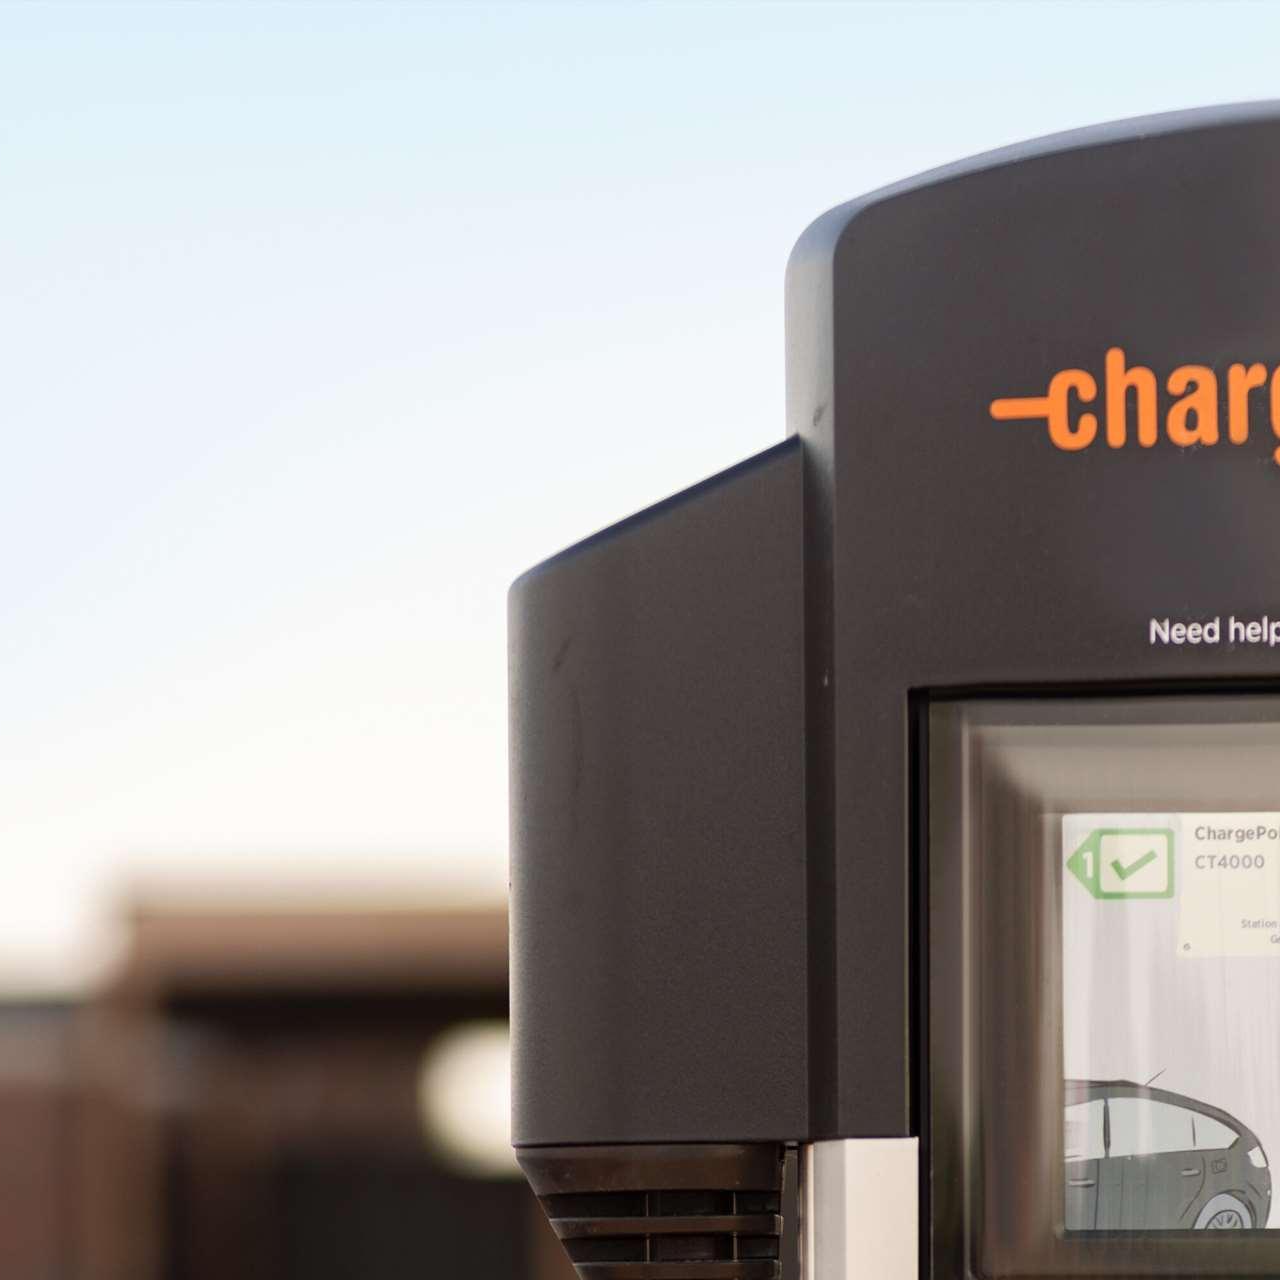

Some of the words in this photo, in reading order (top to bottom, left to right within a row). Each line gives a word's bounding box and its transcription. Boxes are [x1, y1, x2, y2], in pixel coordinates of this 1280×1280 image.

[1150, 618, 1220, 644] Need
[1082, 851, 1094, 879] 1
[1195, 854, 1265, 869] CT4000
[1241, 919, 1277, 929] Station
